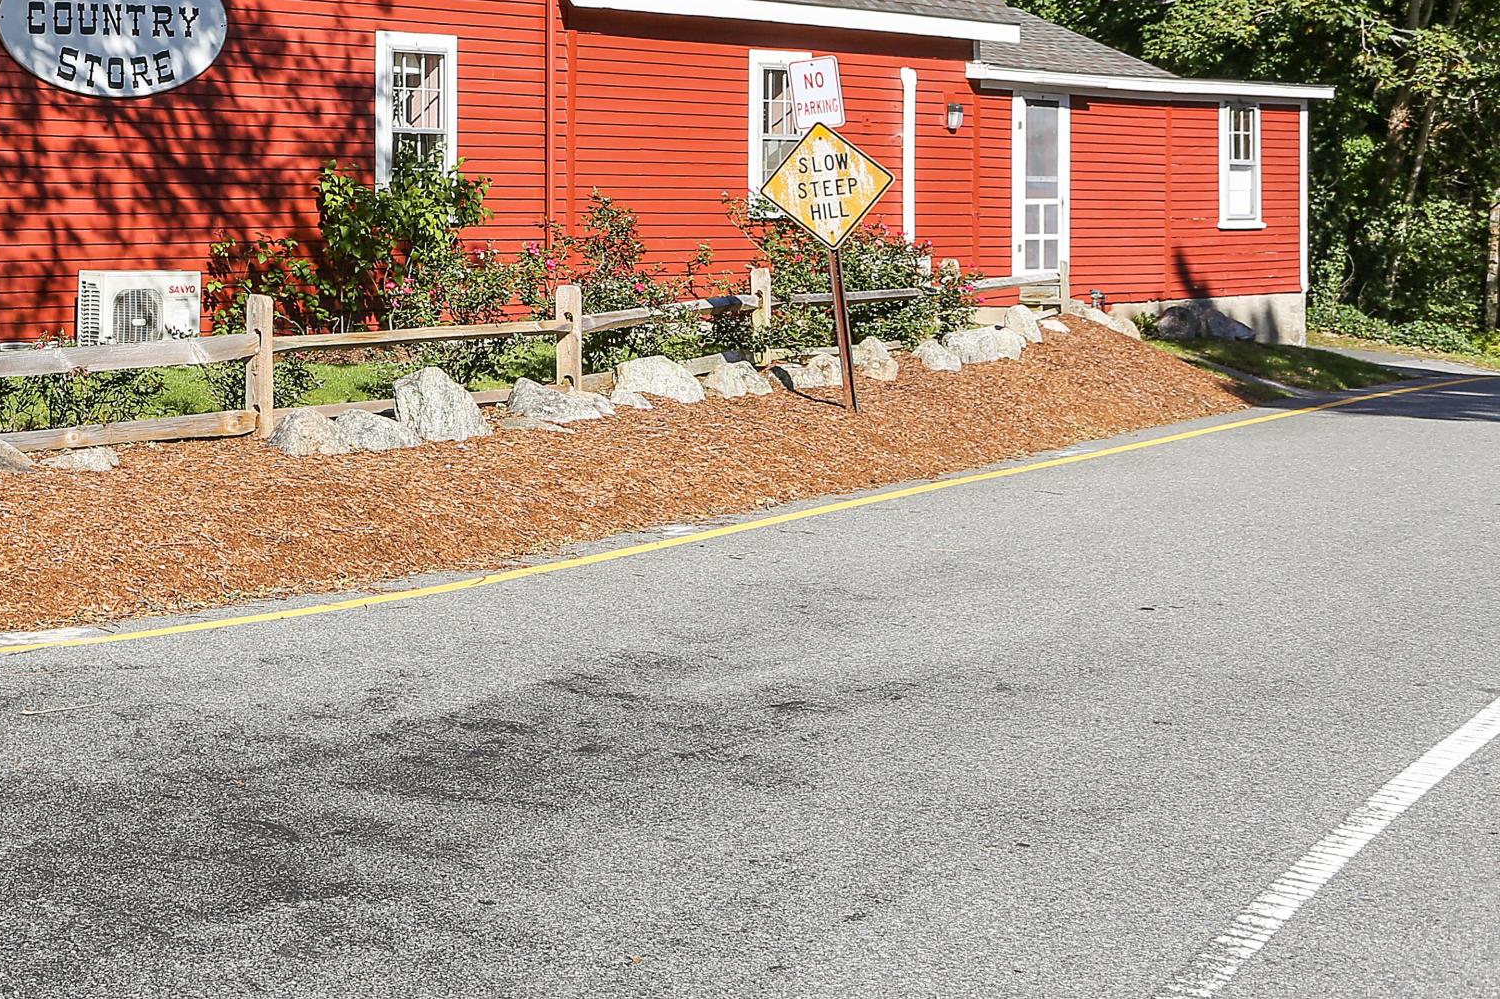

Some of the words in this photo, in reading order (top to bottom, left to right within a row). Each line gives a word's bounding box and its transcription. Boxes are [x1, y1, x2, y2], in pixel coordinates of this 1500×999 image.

[27, 1, 200, 38] COUNTRY
[56, 47, 175, 89] STORE
[803, 71, 824, 90] NO
[796, 98, 839, 117] PARKING
[798, 153, 849, 174] SLOW
[797, 177, 858, 199] STEEP
[810, 202, 850, 221] HILL
[168, 285, 196, 294] SANYO
